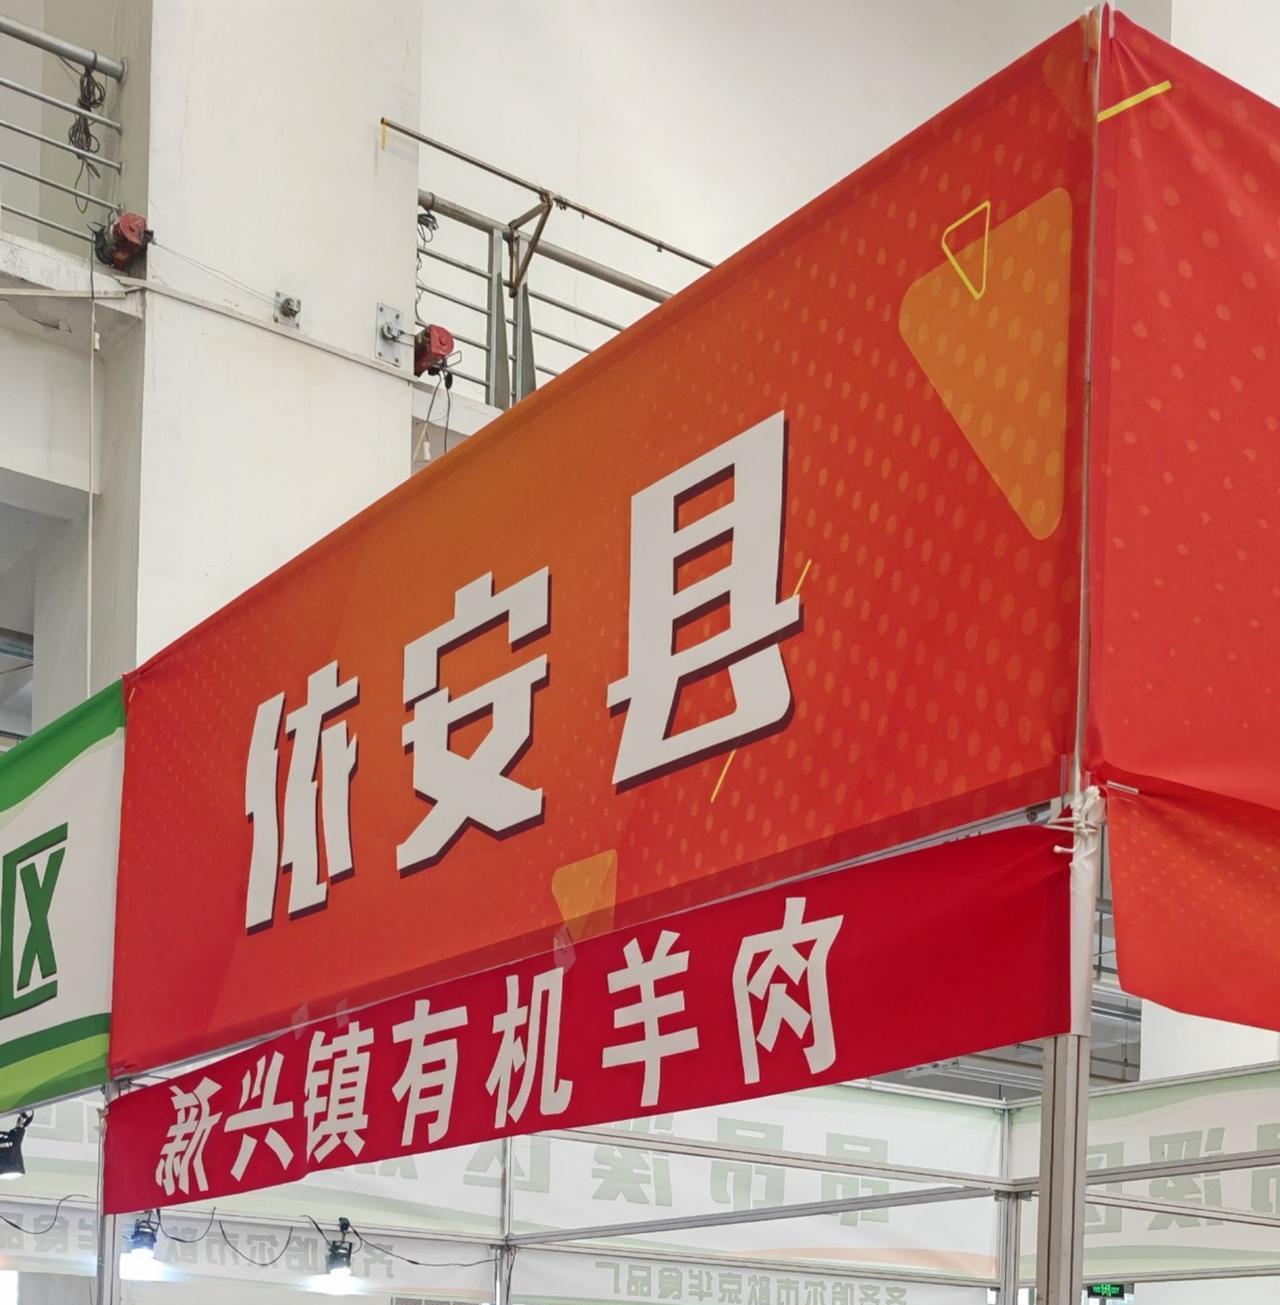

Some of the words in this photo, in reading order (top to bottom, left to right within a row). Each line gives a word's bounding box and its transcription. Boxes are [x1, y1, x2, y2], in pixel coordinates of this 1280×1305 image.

[245, 410, 802, 937] 依安县
[155, 896, 844, 1197] 新兴镇有机羊肉
